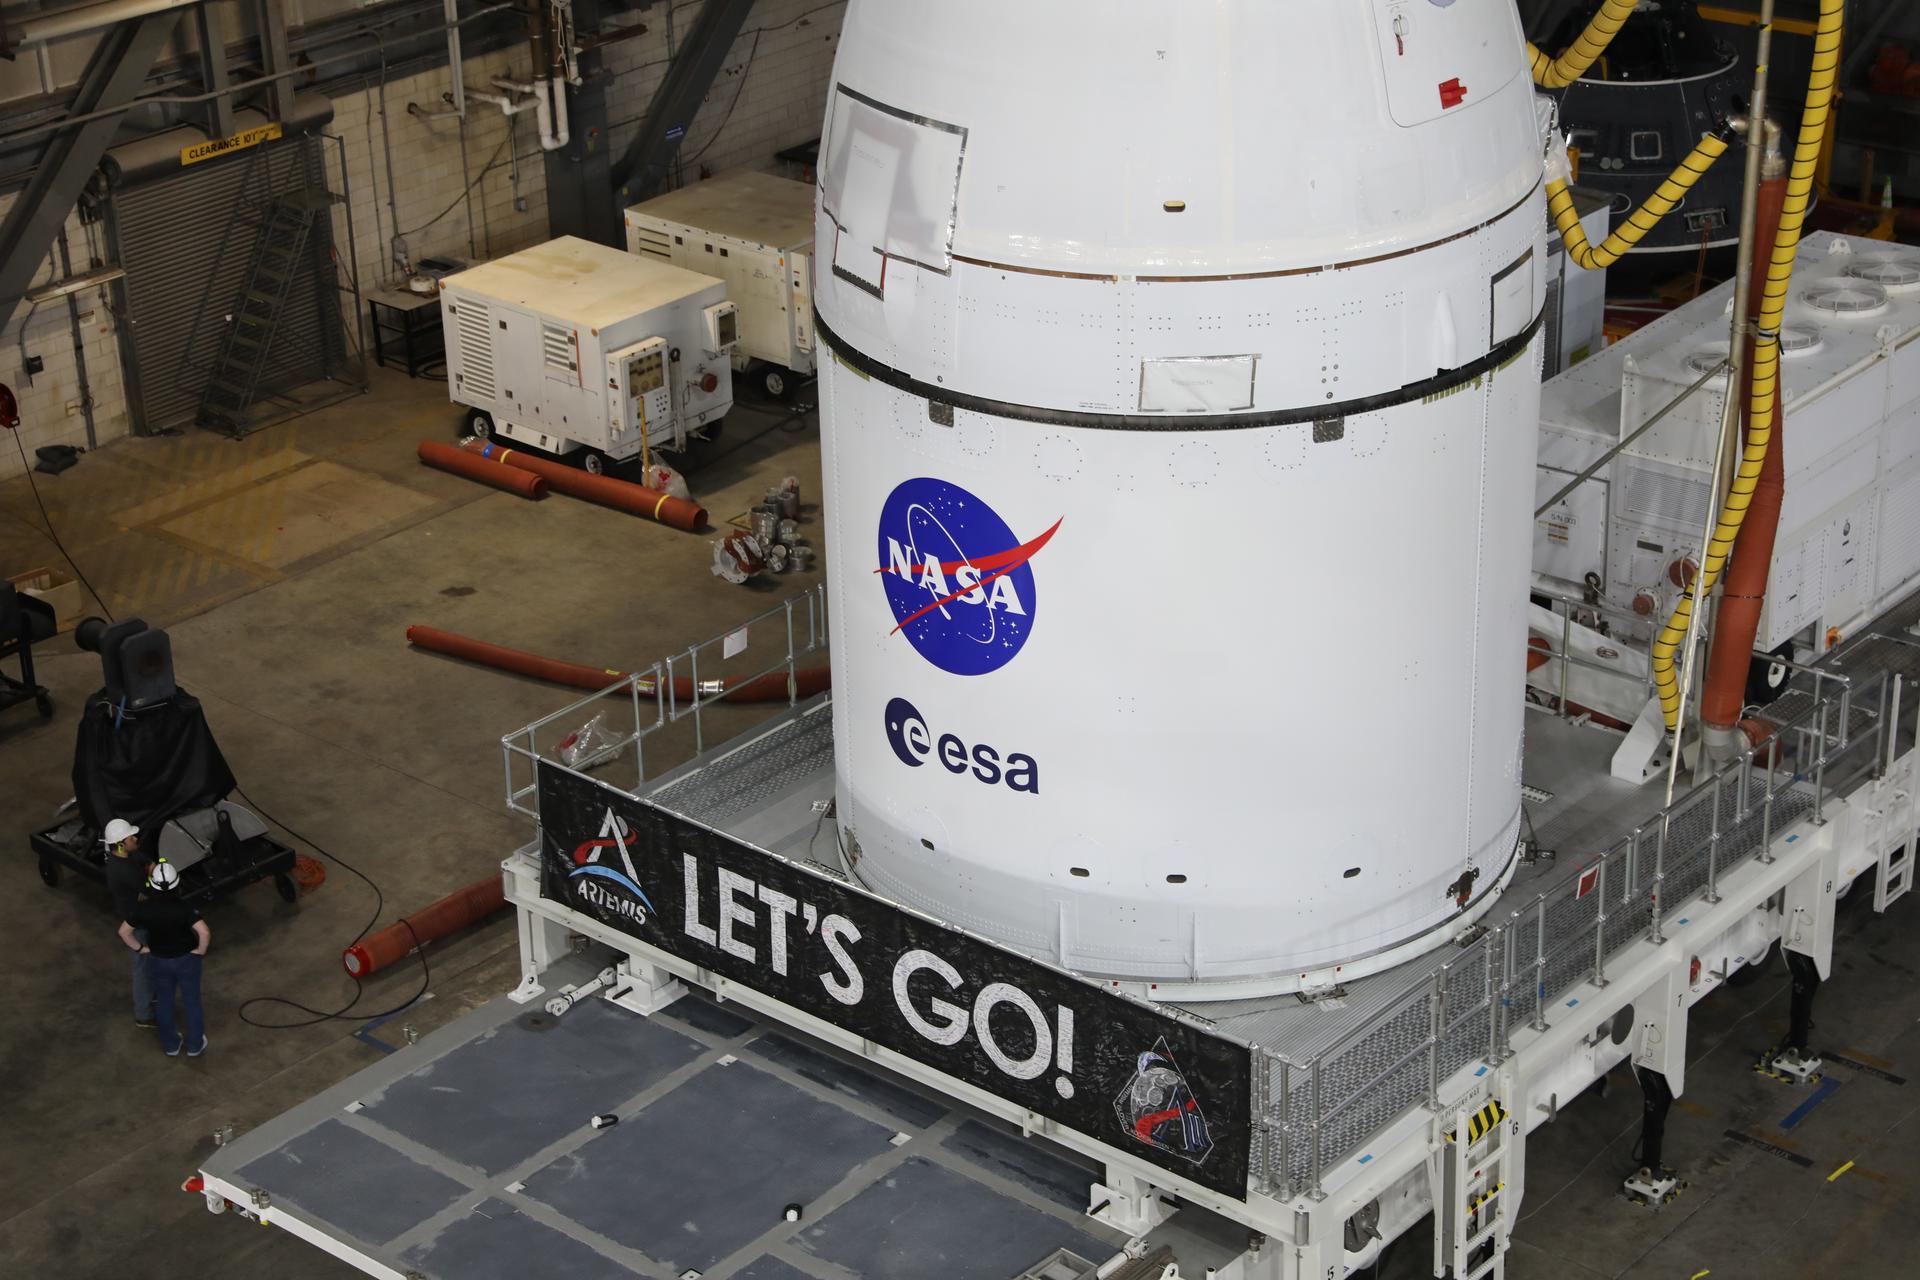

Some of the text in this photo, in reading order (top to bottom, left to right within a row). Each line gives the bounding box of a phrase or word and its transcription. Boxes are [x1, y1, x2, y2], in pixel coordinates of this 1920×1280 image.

[188, 137, 241, 159] CLEARANCE
[886, 536, 1028, 617] NASA
[937, 732, 1040, 796] esa
[577, 879, 647, 926] ARTEMIS
[683, 852, 1075, 1100] LET'S GO!
